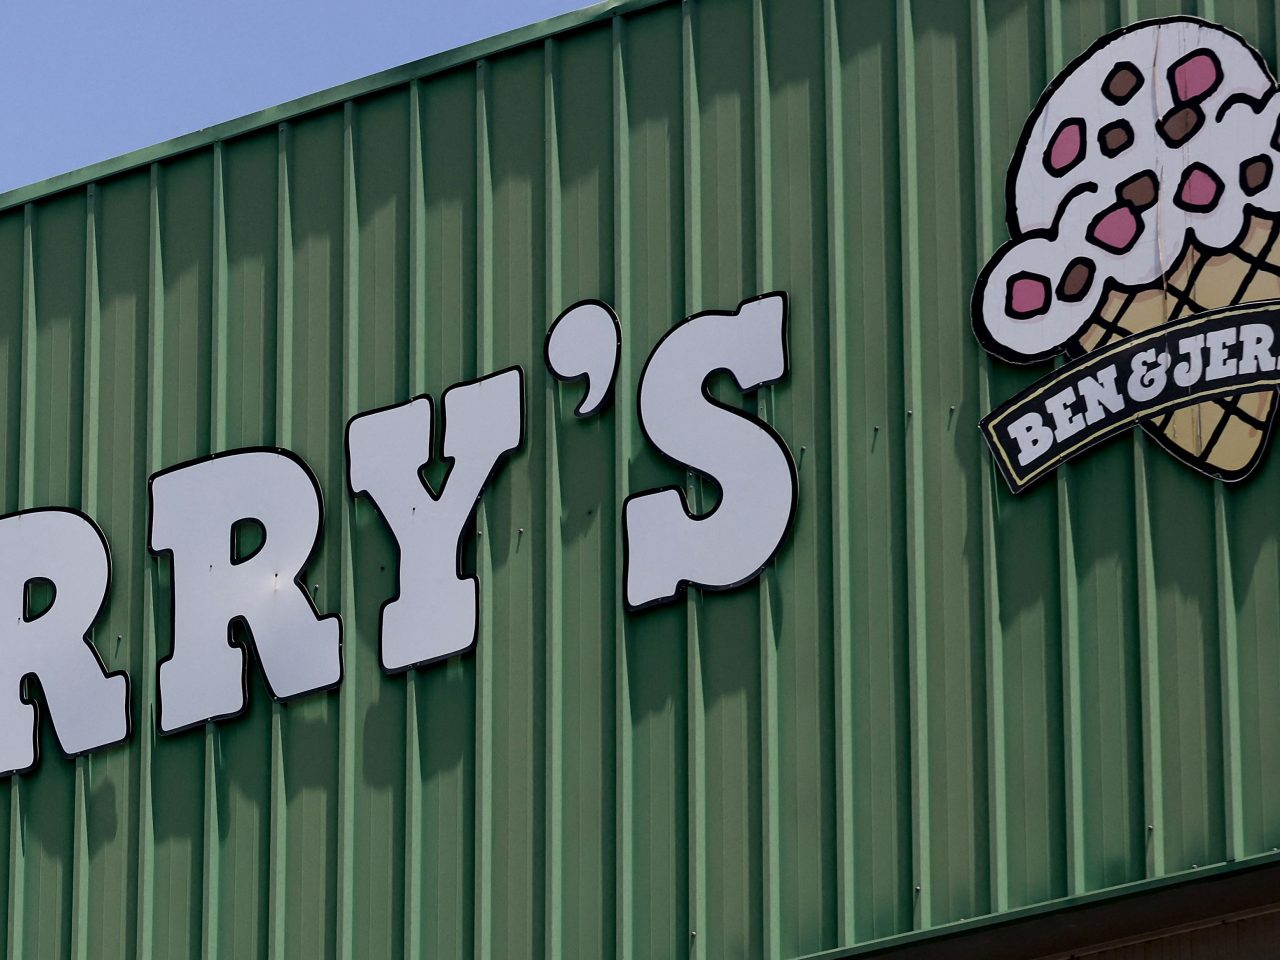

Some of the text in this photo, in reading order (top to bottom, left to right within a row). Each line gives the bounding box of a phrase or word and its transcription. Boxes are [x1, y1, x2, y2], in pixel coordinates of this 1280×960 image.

[1007, 323, 1280, 466] BEN & JER
